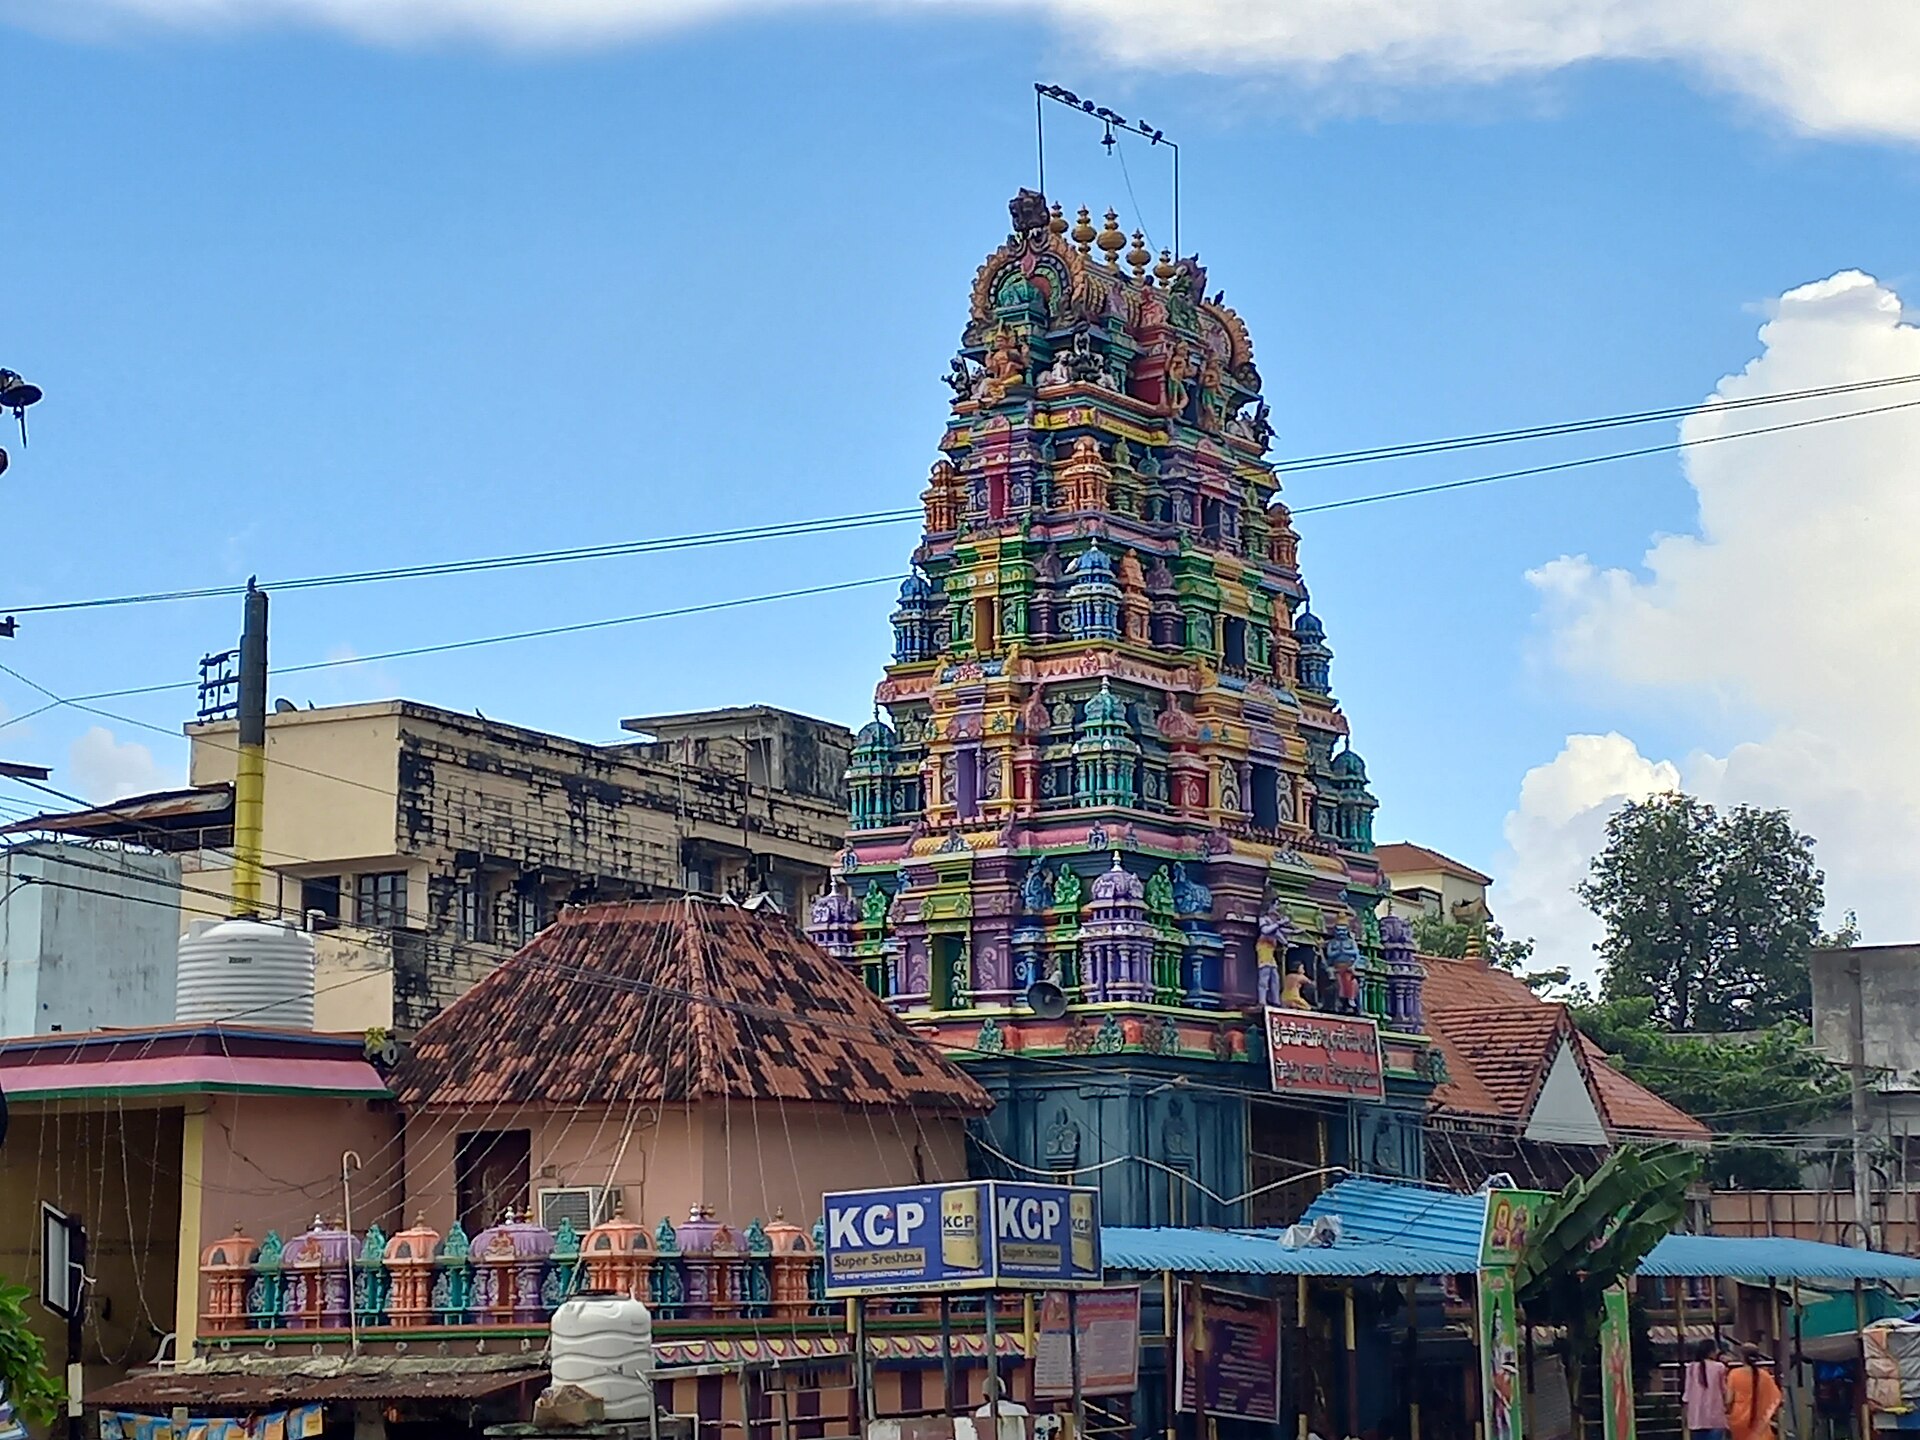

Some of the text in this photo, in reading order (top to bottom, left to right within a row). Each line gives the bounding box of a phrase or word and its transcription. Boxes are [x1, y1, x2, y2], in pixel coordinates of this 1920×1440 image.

[829, 1203, 925, 1248] KCP
[942, 1214, 975, 1229] KCP
[998, 1196, 1061, 1241] KCP
[833, 1251, 923, 1269] Super Sreshtaa
